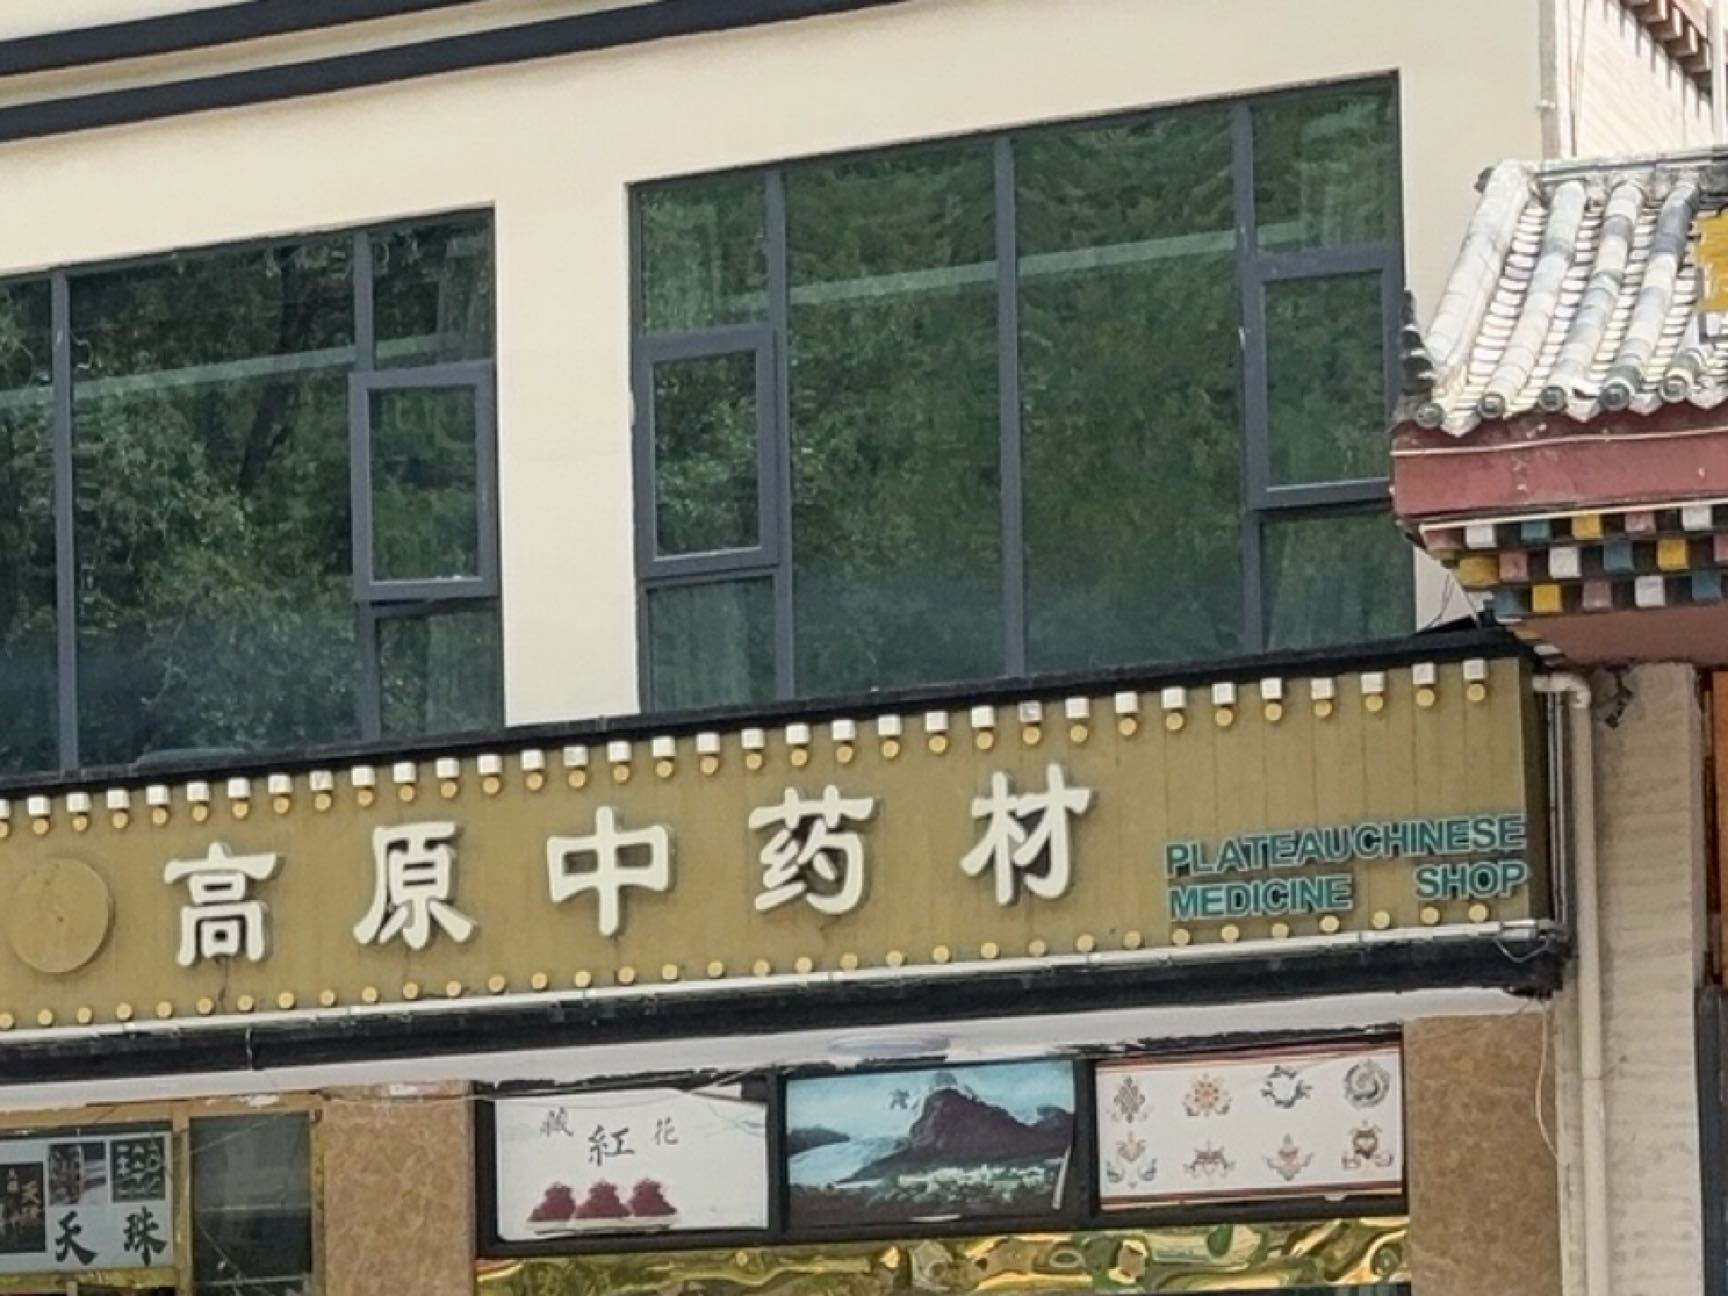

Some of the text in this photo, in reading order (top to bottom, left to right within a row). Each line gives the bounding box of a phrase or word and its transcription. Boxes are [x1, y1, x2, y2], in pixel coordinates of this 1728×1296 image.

[164, 763, 1090, 967] 高原中药材
[1167, 861, 1527, 920] MEDICINE SHOP
